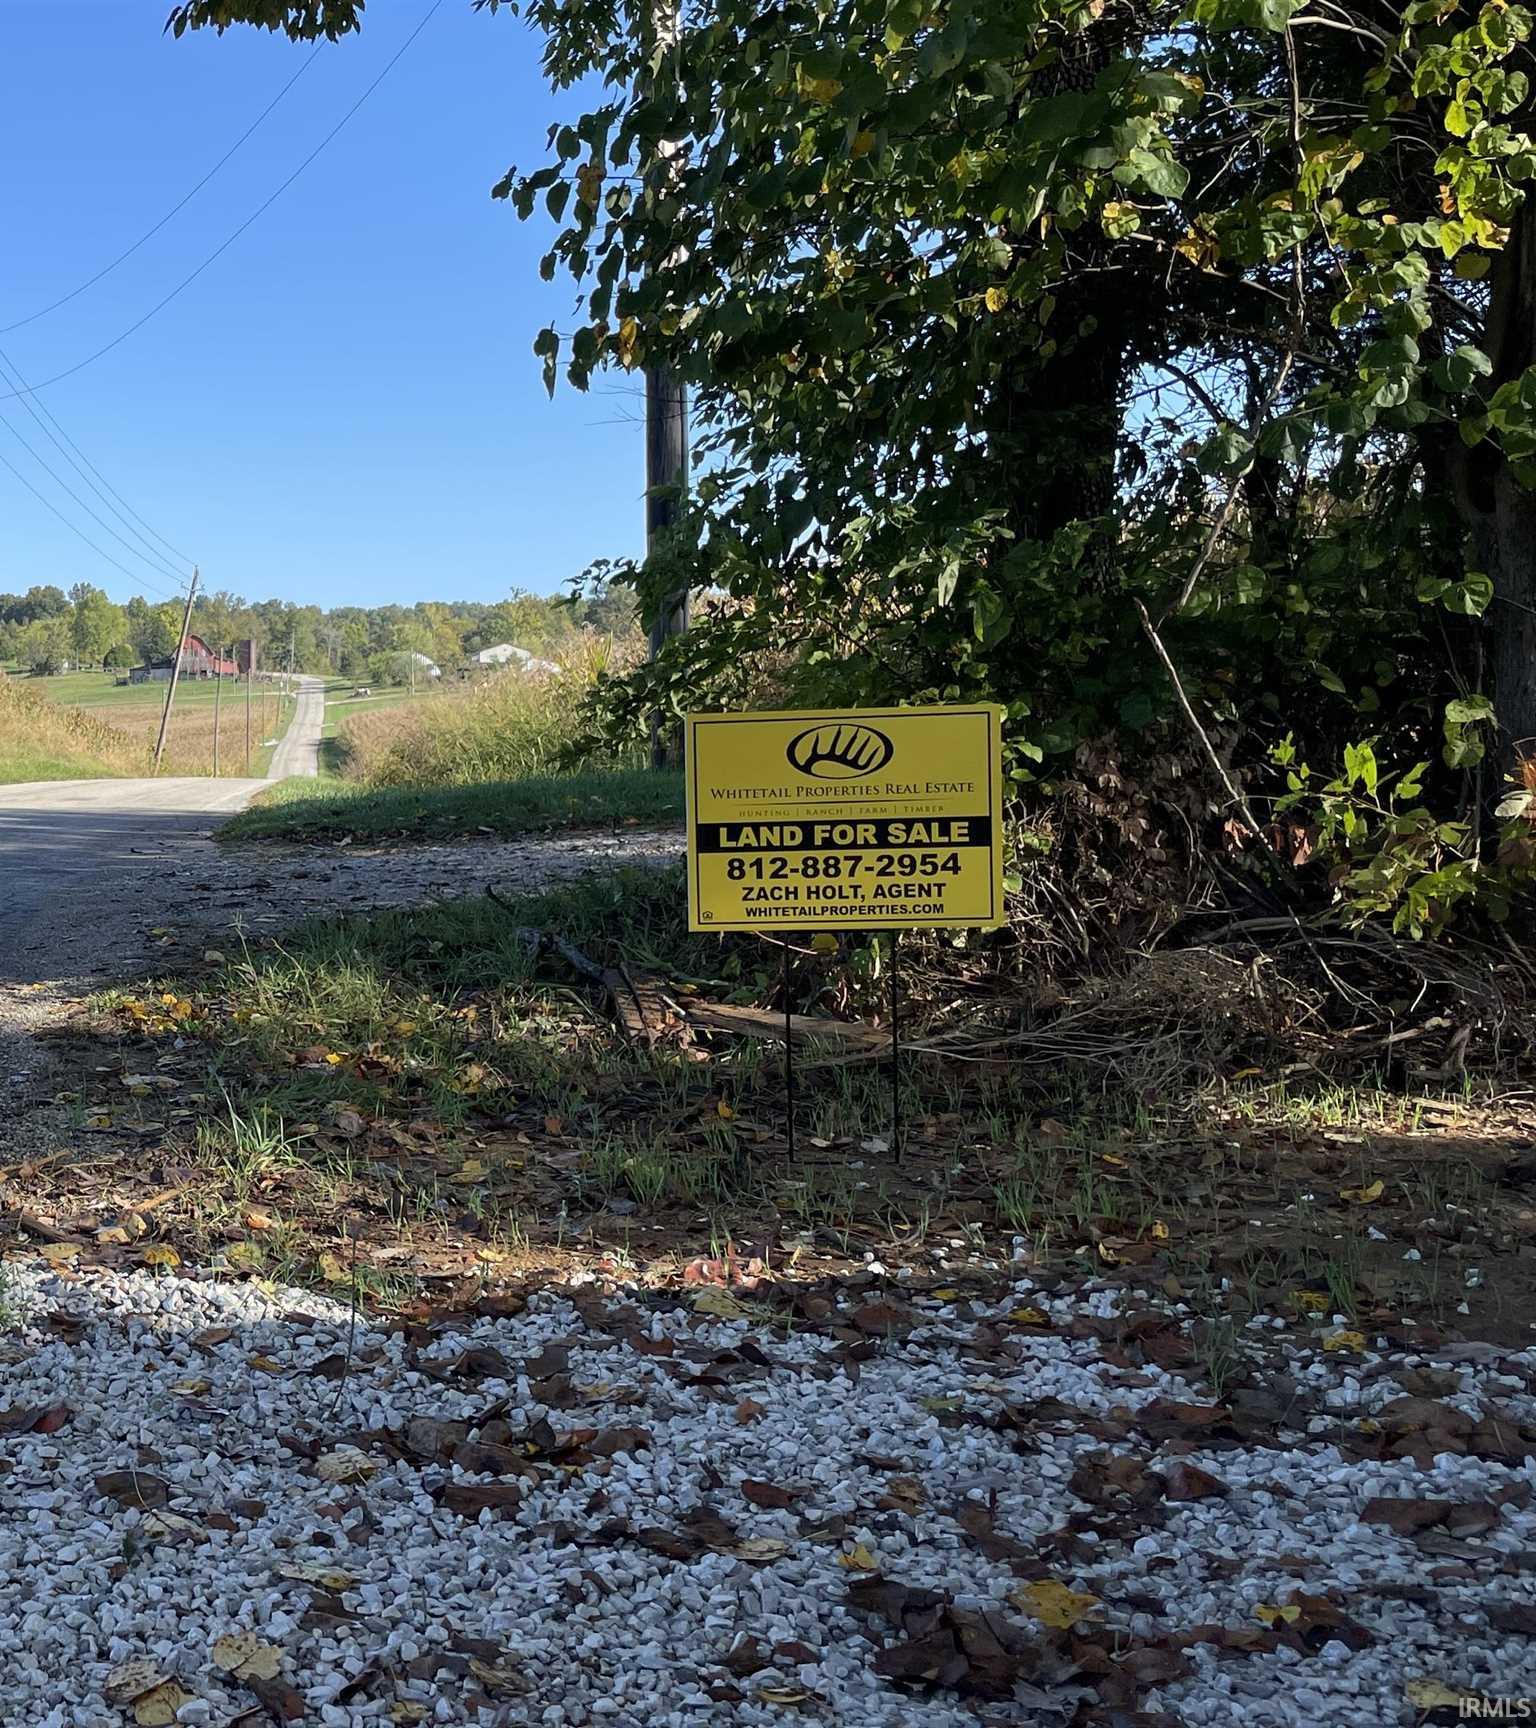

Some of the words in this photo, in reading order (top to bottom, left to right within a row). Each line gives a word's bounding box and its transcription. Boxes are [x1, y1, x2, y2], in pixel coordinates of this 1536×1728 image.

[711, 787, 791, 800] WHITETAIL
[796, 785, 880, 798] PROPERTIES
[886, 783, 921, 795] REAL
[925, 782, 975, 794] ESTATE
[739, 808, 790, 818] HUNTING
[806, 807, 843, 816] RANCH
[859, 806, 888, 815] FARM
[904, 805, 944, 813] TIMBER
[719, 826, 803, 848] LAND
[814, 824, 878, 846] FOR
[887, 822, 970, 844] SALE
[727, 852, 961, 880] 812-887-2954
[742, 886, 799, 901] ZACH
[806, 884, 866, 903] HOLT,
[873, 883, 946, 899] AGENT
[745, 903, 944, 917] WHITETAILPROPERTIES.COM
